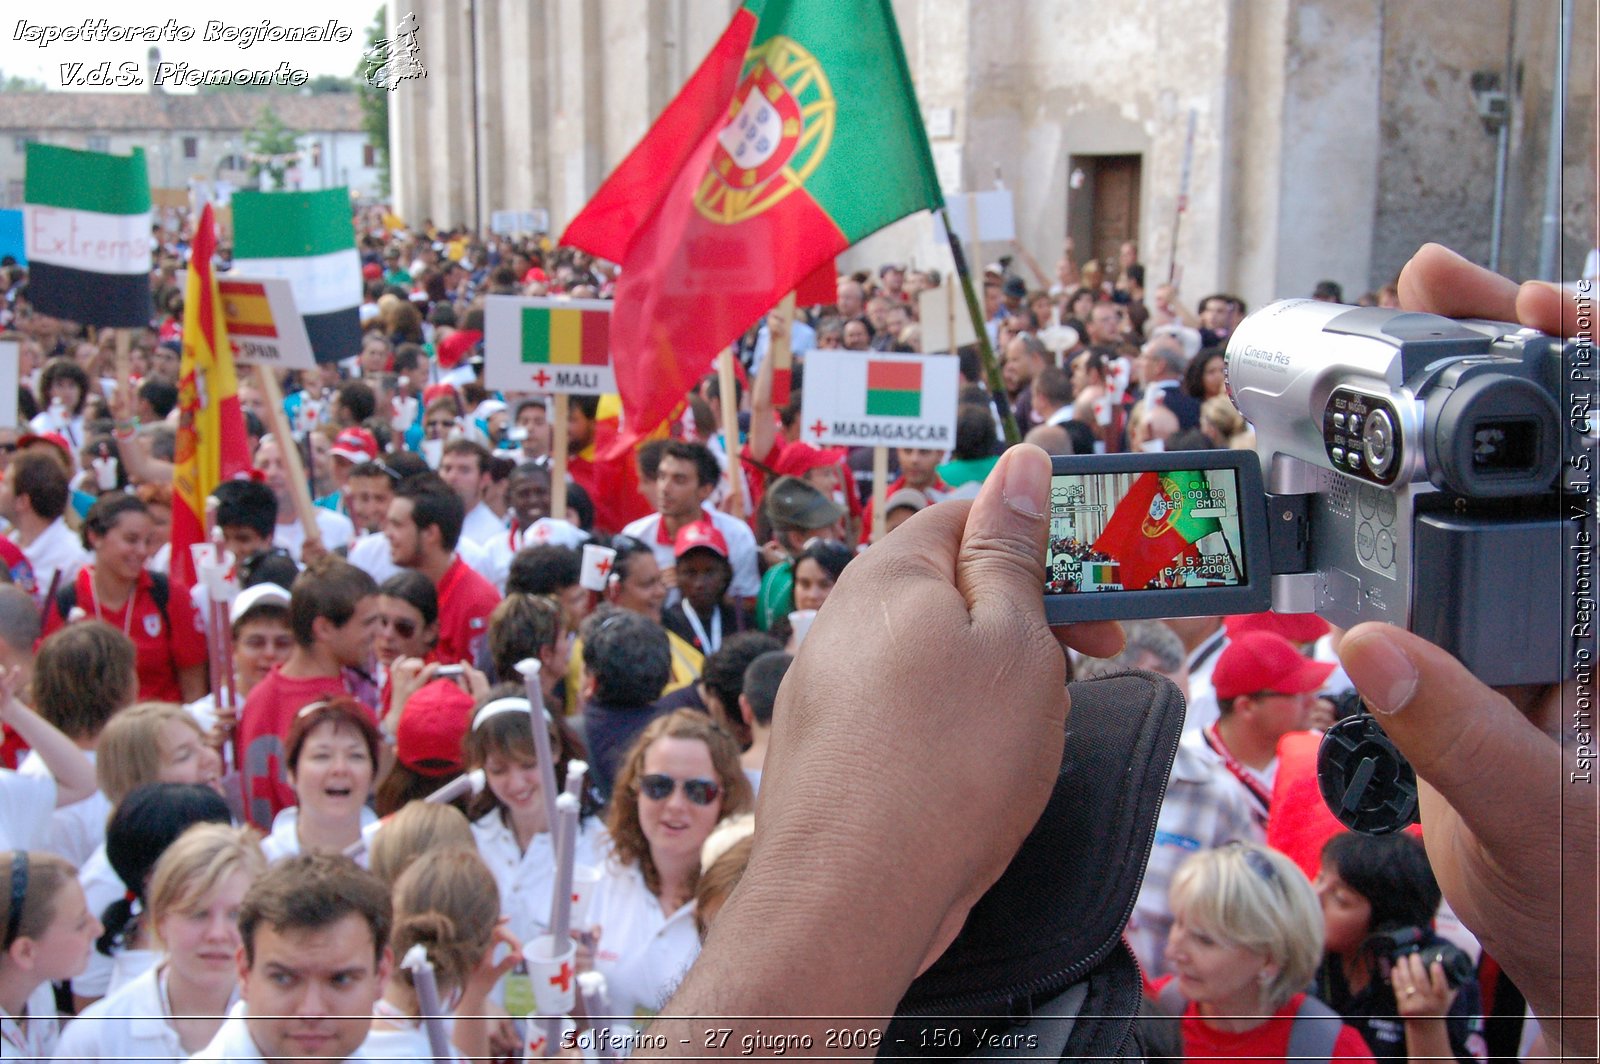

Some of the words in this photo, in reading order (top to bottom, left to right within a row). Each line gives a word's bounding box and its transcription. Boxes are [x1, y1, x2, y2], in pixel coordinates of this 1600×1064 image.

[242, 342, 280, 358] SPAIN
[555, 371, 598, 388] MALI
[832, 422, 949, 440] MADAGASCAR
[1159, 500, 1182, 510] REM
[1196, 499, 1226, 509] 6MIN
[1185, 554, 1230, 566] 5:15PM
[1052, 571, 1083, 581] XTRA
[1164, 564, 1231, 576] 6/27/2008
